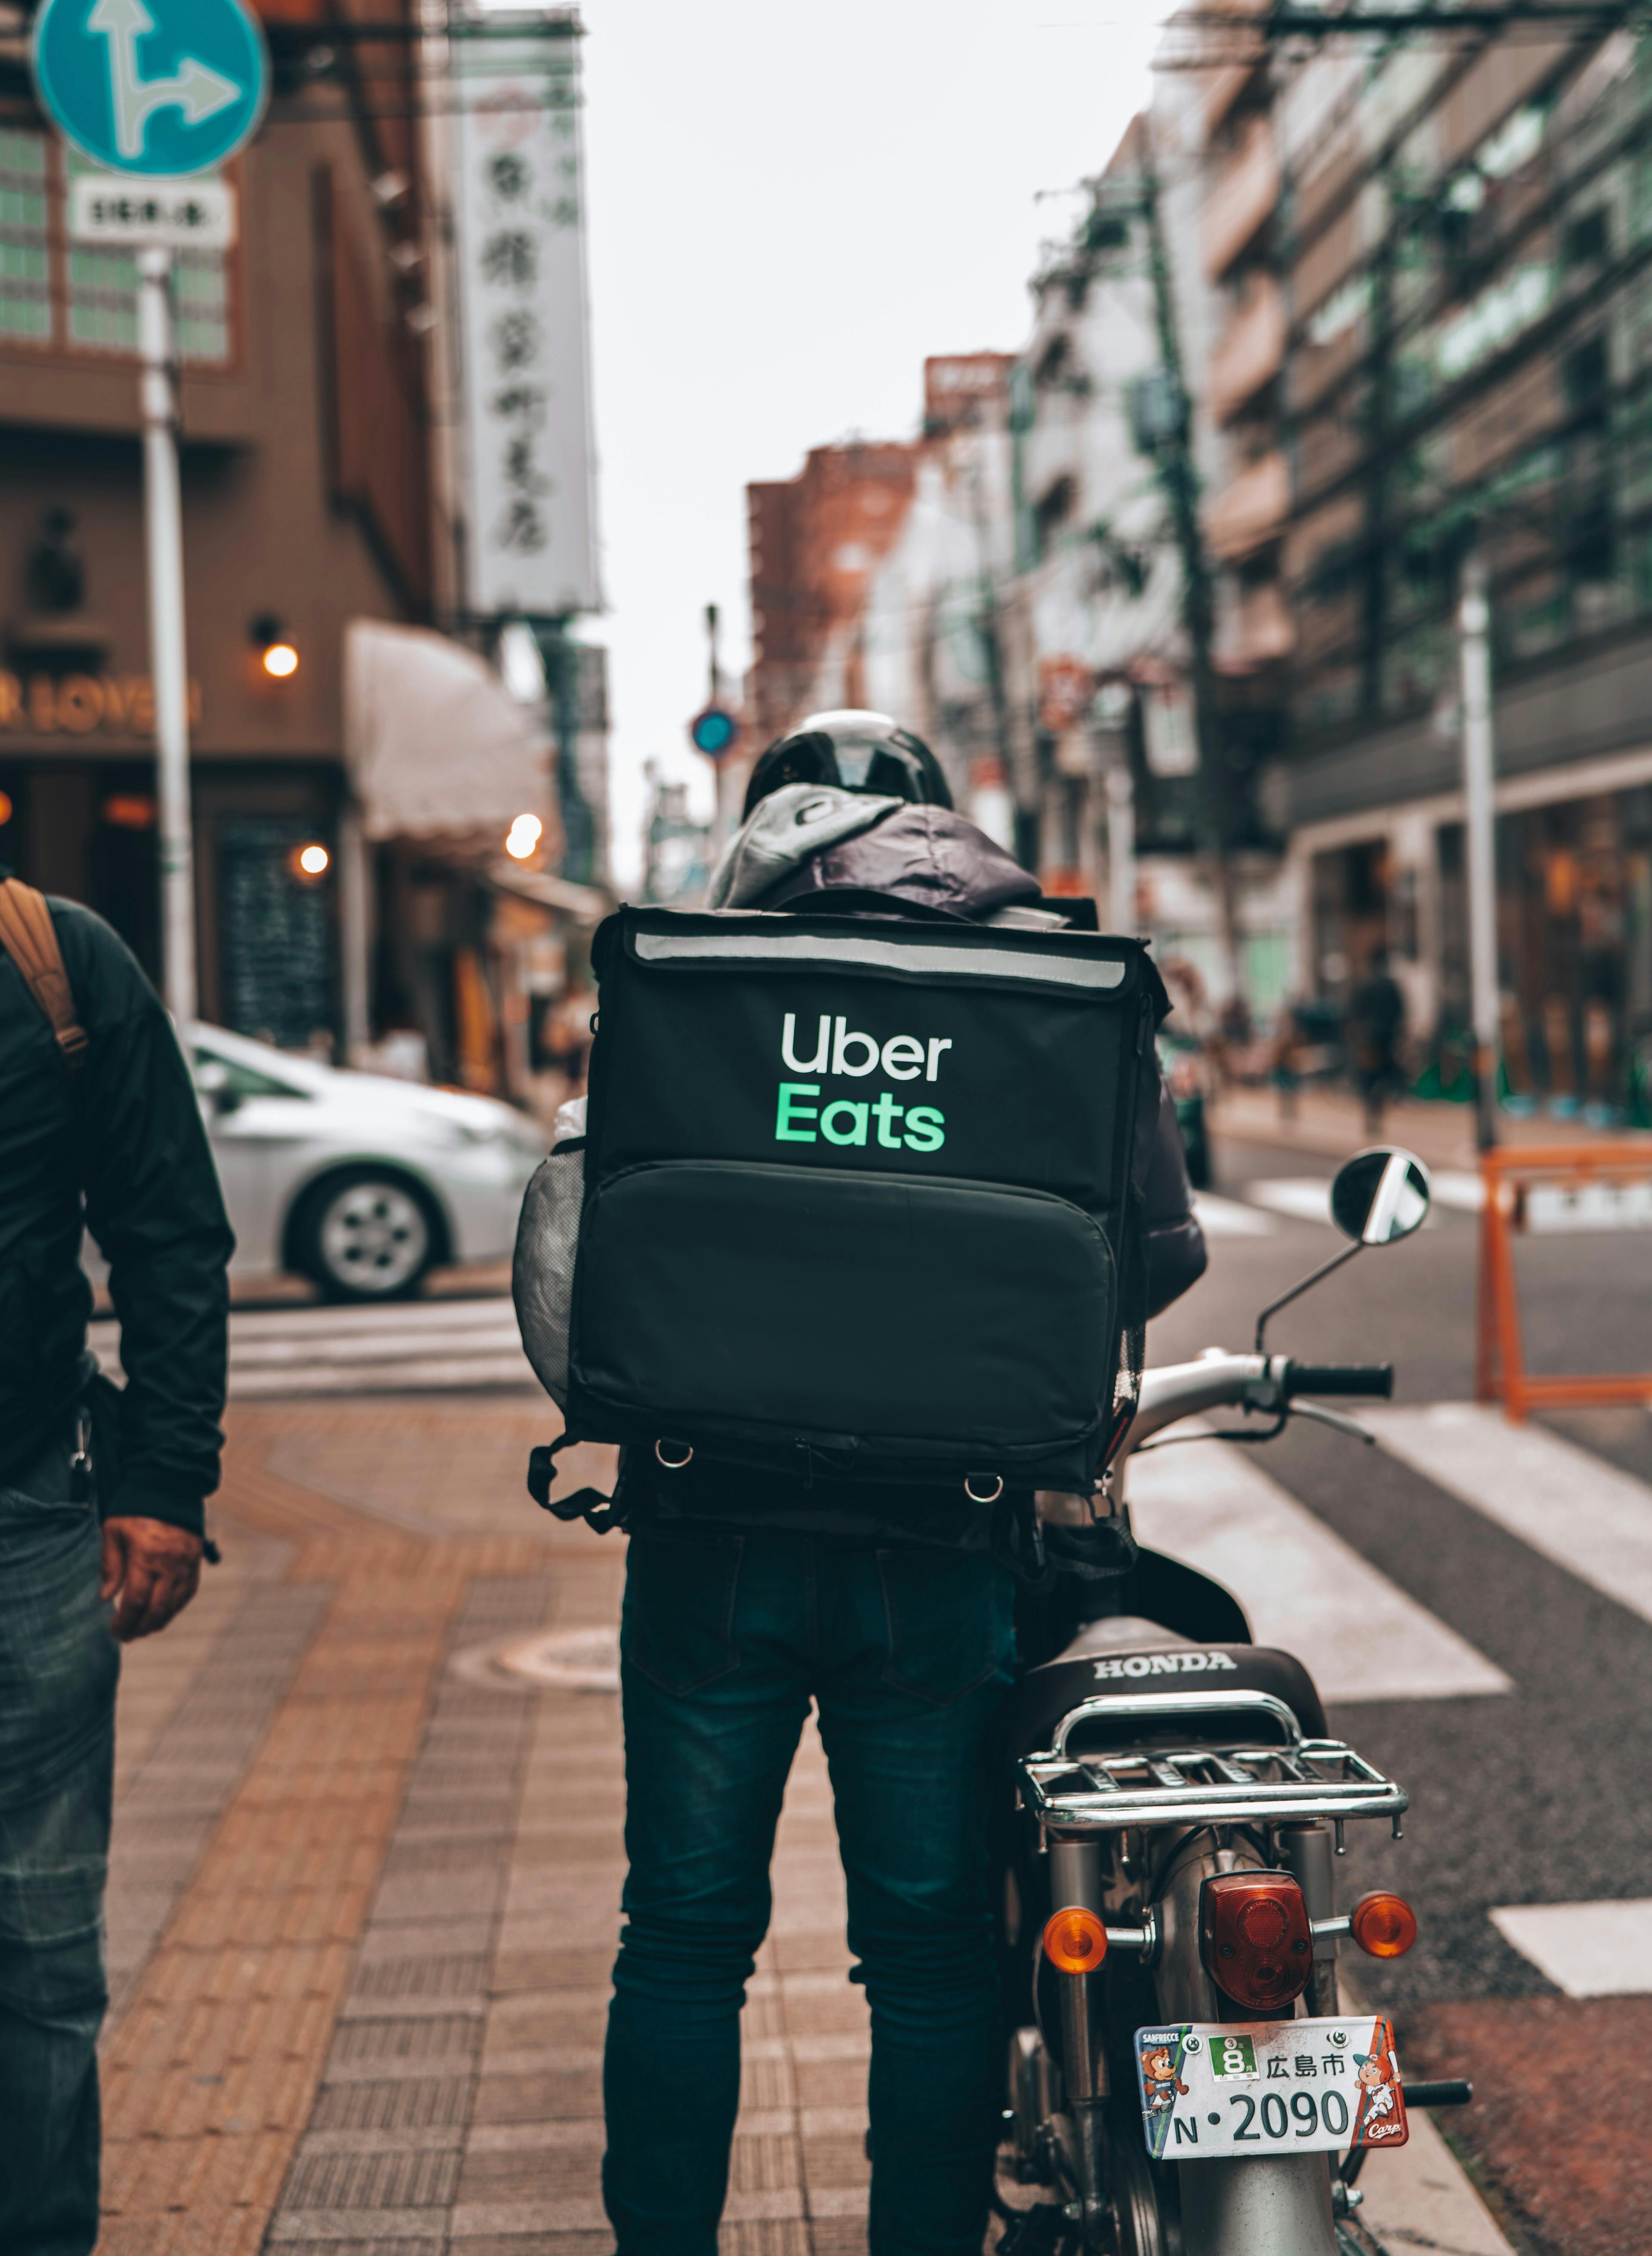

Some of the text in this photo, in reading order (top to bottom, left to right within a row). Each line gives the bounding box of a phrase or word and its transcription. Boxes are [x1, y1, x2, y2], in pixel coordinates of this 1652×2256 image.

[781, 1013, 952, 1082] Uber
[775, 1082, 945, 1152] Eats
[1093, 1651, 1238, 1679] HONDA
[1142, 2033, 1180, 2043] SANFRECCE
[1267, 2053, 1345, 2079] 広島市
[1368, 2123, 1401, 2139] Carp
